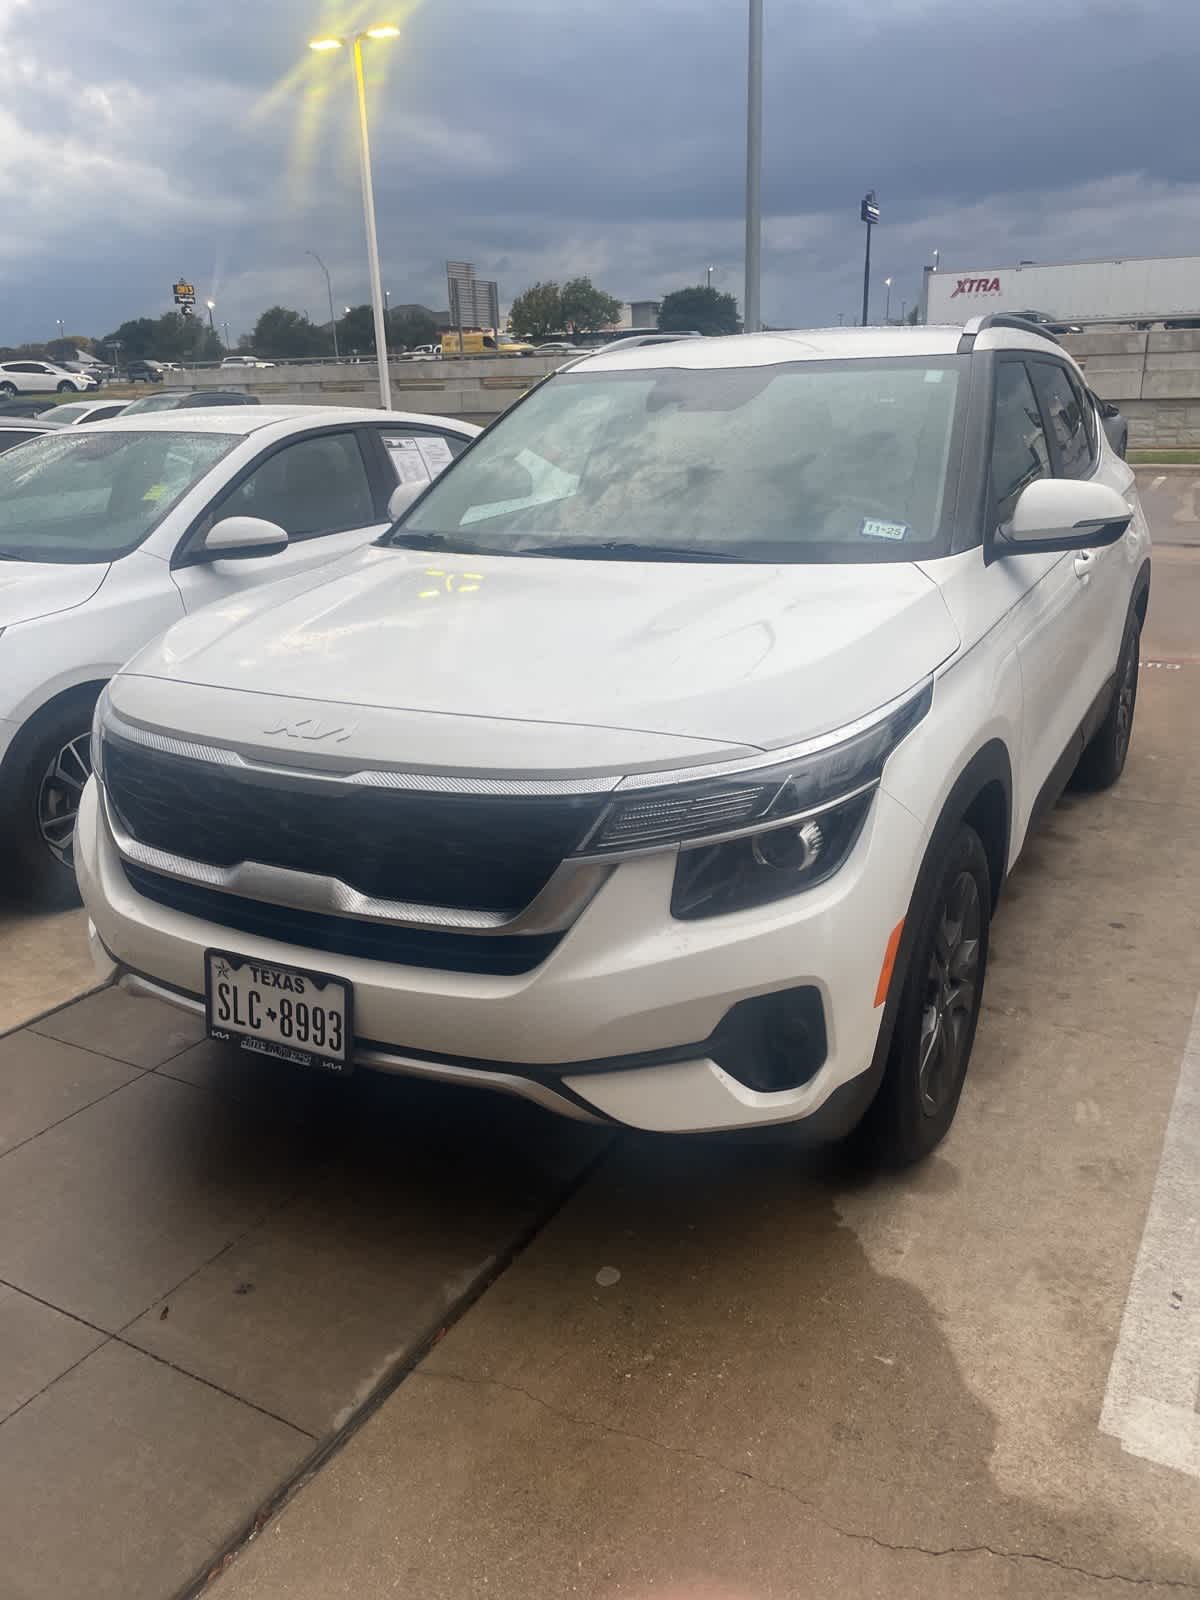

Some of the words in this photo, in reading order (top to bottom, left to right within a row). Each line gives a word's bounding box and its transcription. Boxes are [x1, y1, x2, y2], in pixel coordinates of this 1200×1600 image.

[950, 278, 1001, 298] XTRA
[868, 524, 901, 536] 11-25
[250, 967, 305, 994] TEXAS
